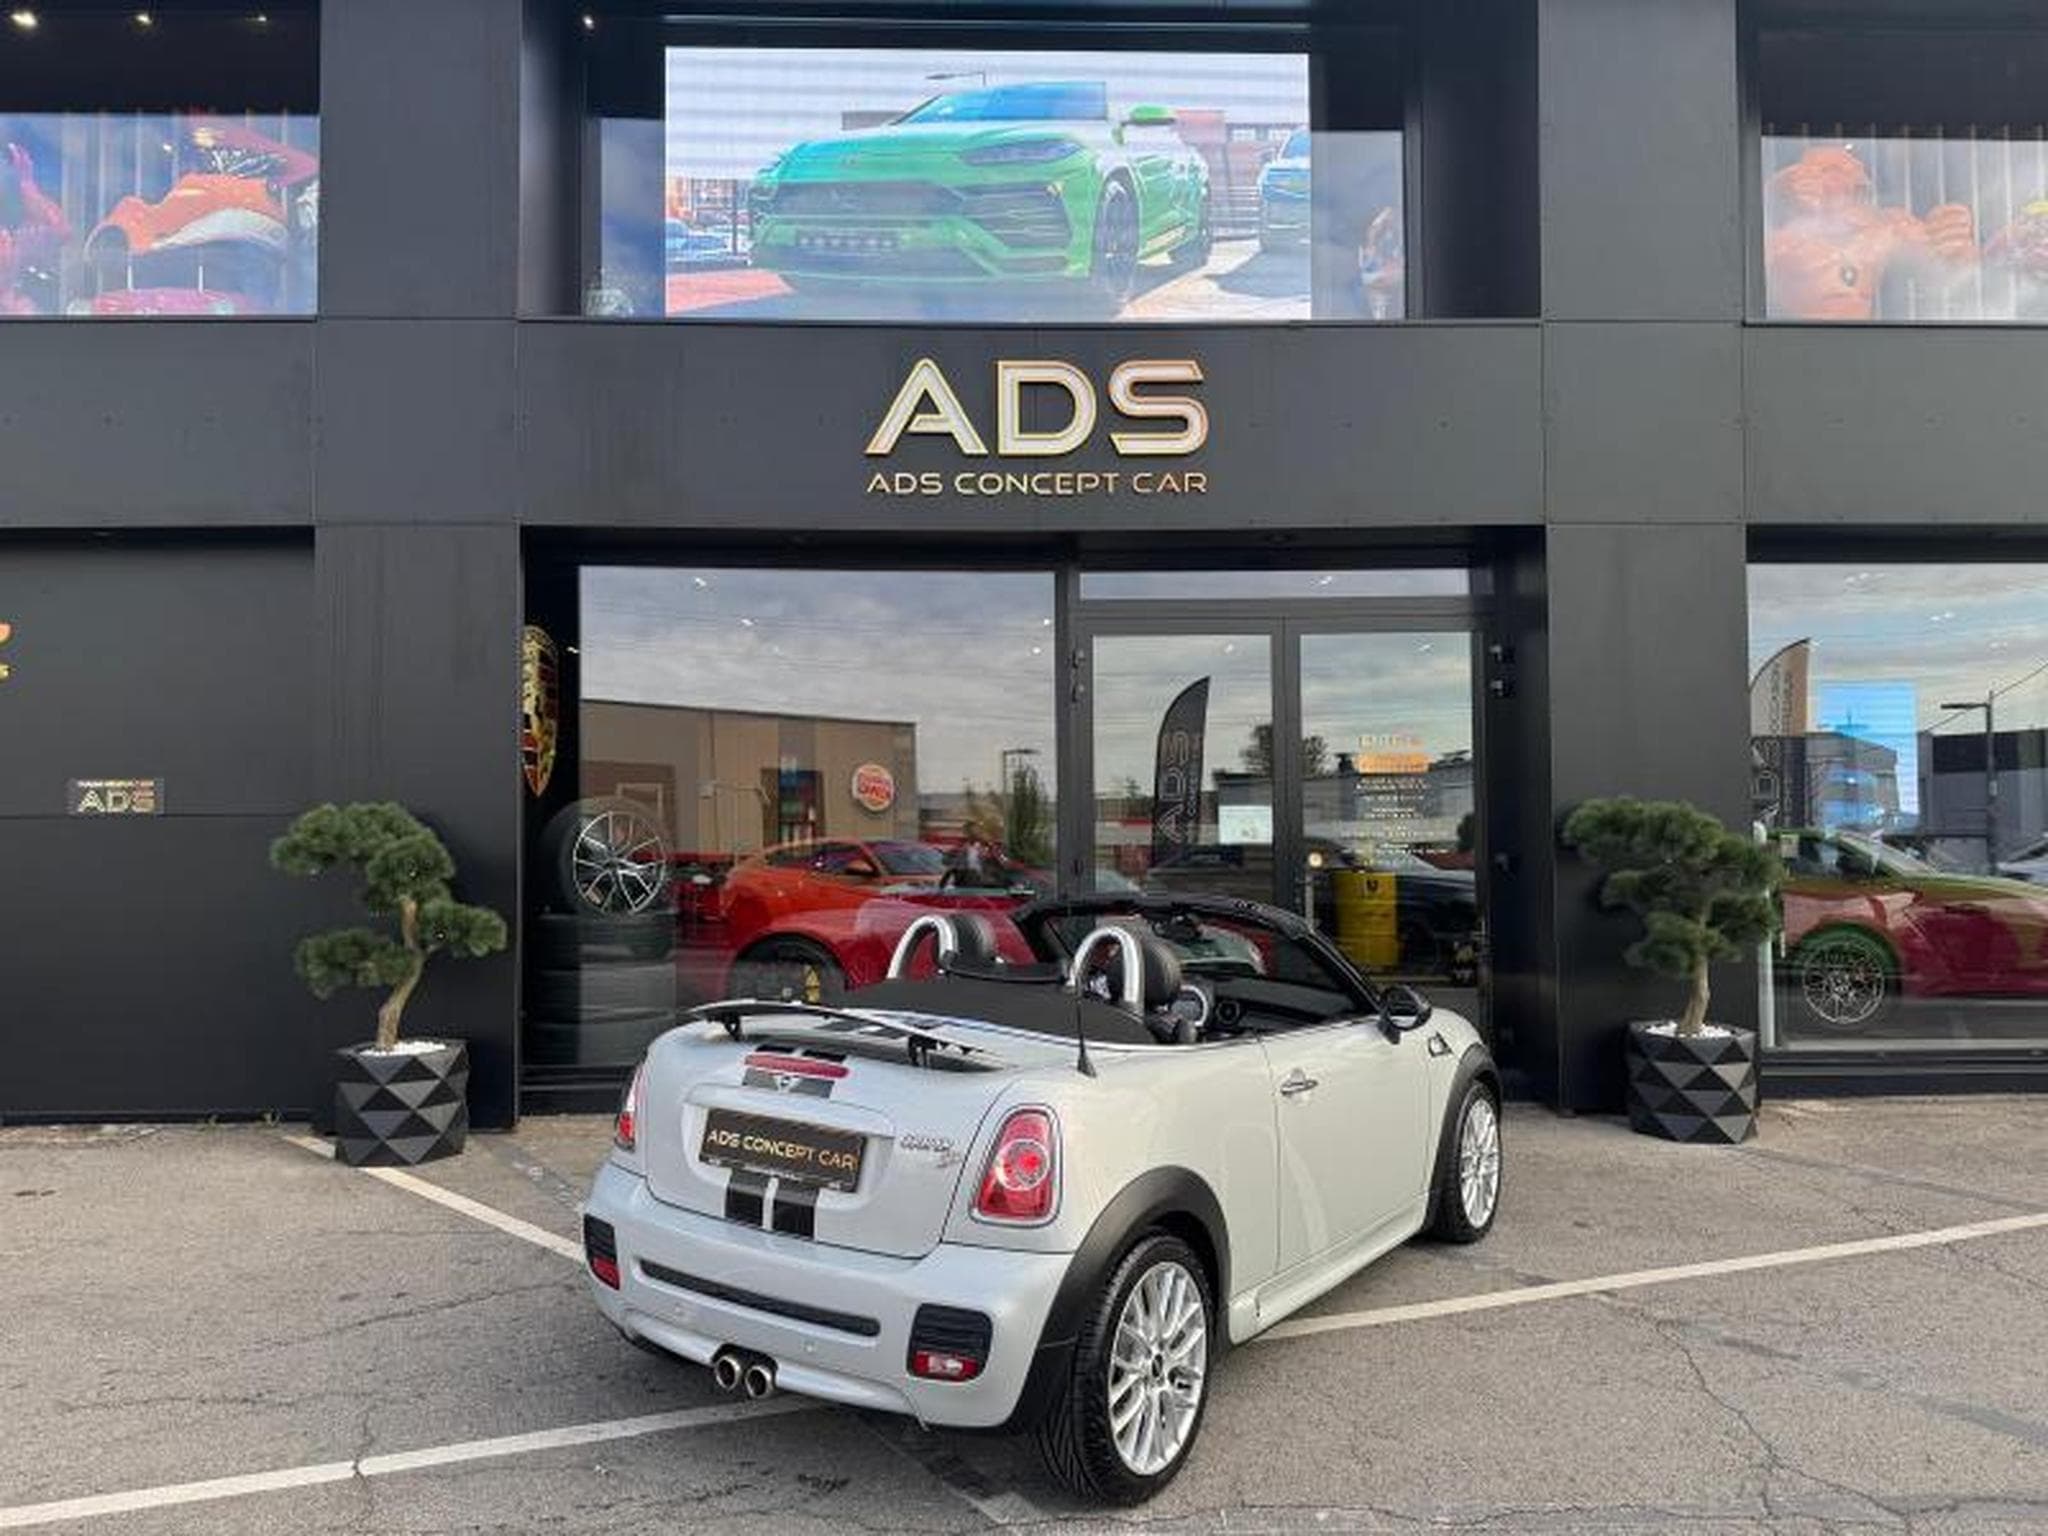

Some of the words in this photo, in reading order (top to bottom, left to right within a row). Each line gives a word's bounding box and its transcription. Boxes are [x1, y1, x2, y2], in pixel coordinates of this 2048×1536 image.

[865, 357, 1209, 455] ADS
[867, 472, 943, 494] ADS
[955, 472, 1120, 494] CONCEPT
[1132, 472, 1208, 494] CAR
[77, 789, 154, 812] ADS
[706, 1129, 741, 1149] ADS
[742, 1134, 815, 1161] CONCEPT
[818, 1149, 856, 1170] CAR
